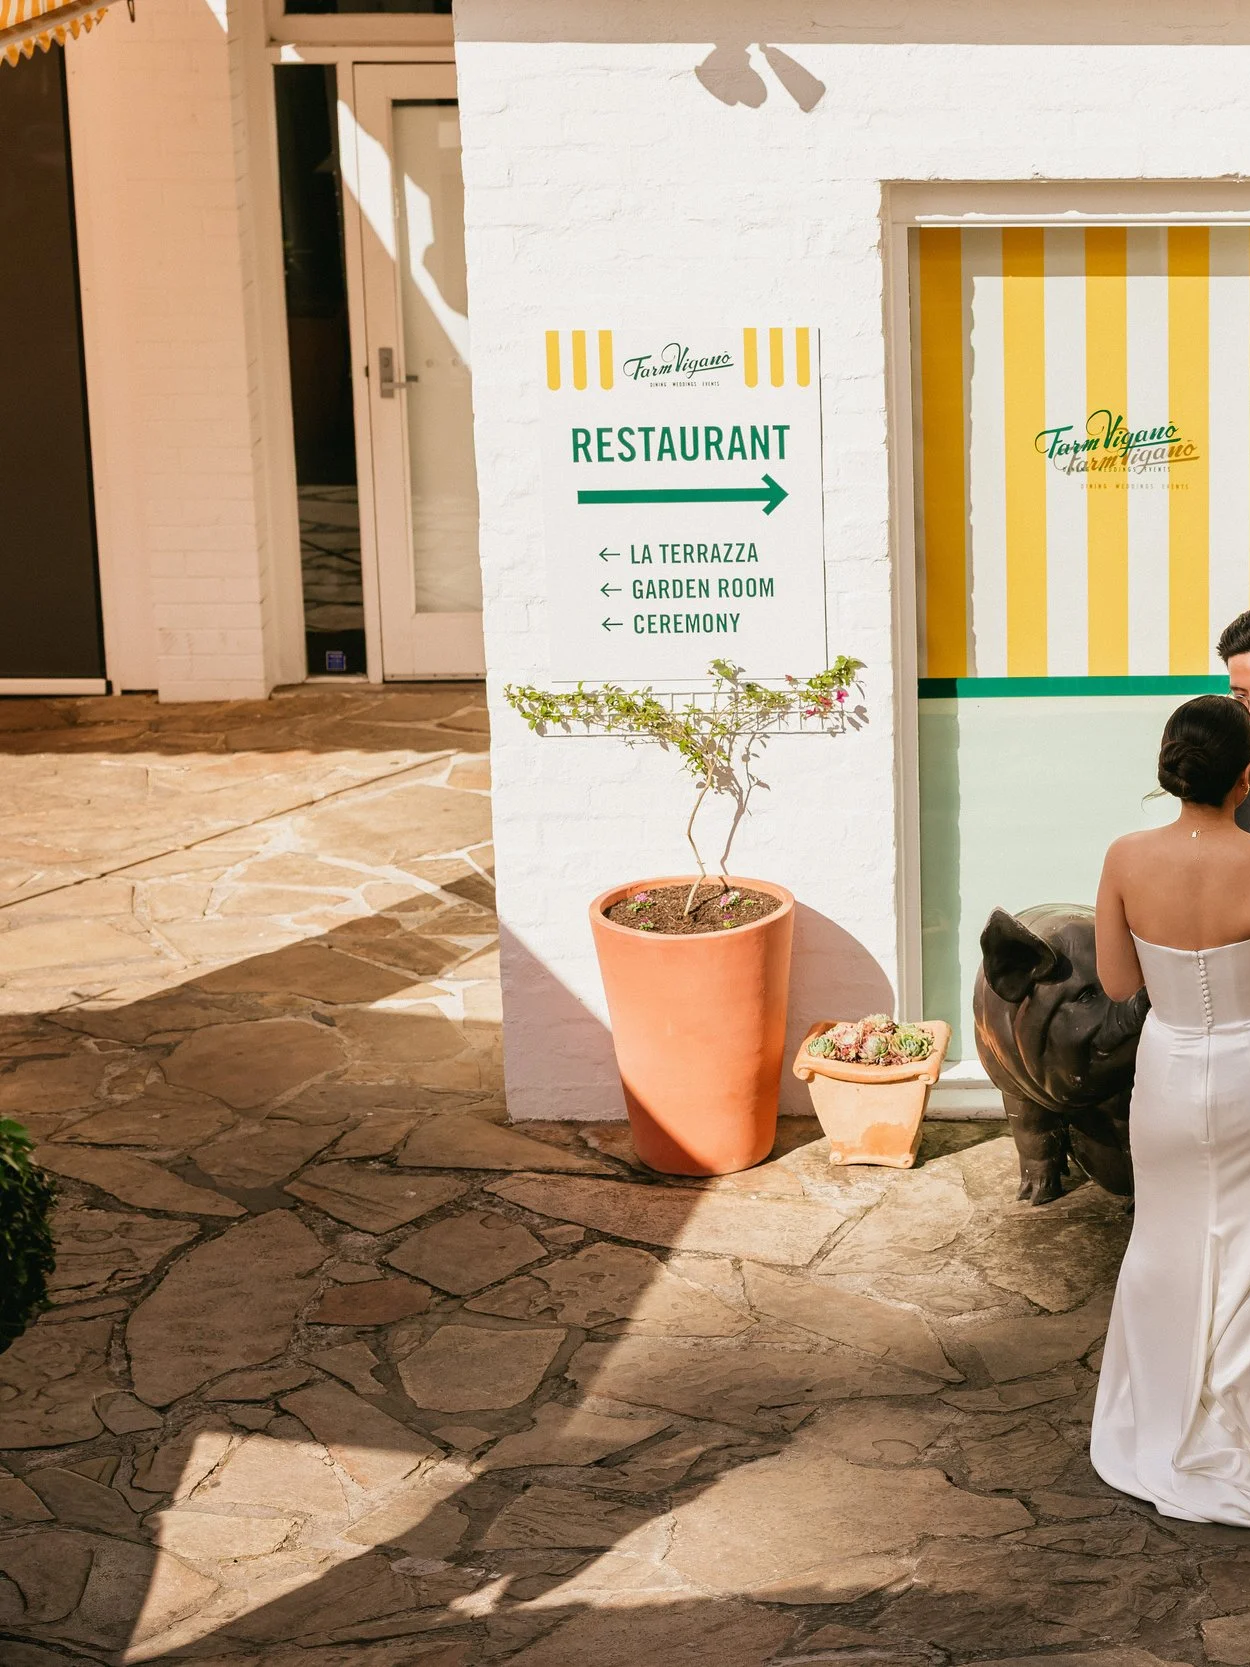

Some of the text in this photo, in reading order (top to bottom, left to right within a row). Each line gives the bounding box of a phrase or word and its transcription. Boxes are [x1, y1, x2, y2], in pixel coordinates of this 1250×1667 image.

[623, 355, 672, 380] Farm
[571, 424, 791, 463] RESTAURANT
[1035, 425, 1100, 459] Farm
[630, 542, 759, 564] LA TERRAZZA
[632, 577, 775, 599] GARDEN ROOM
[633, 612, 741, 634] CEREMONY
